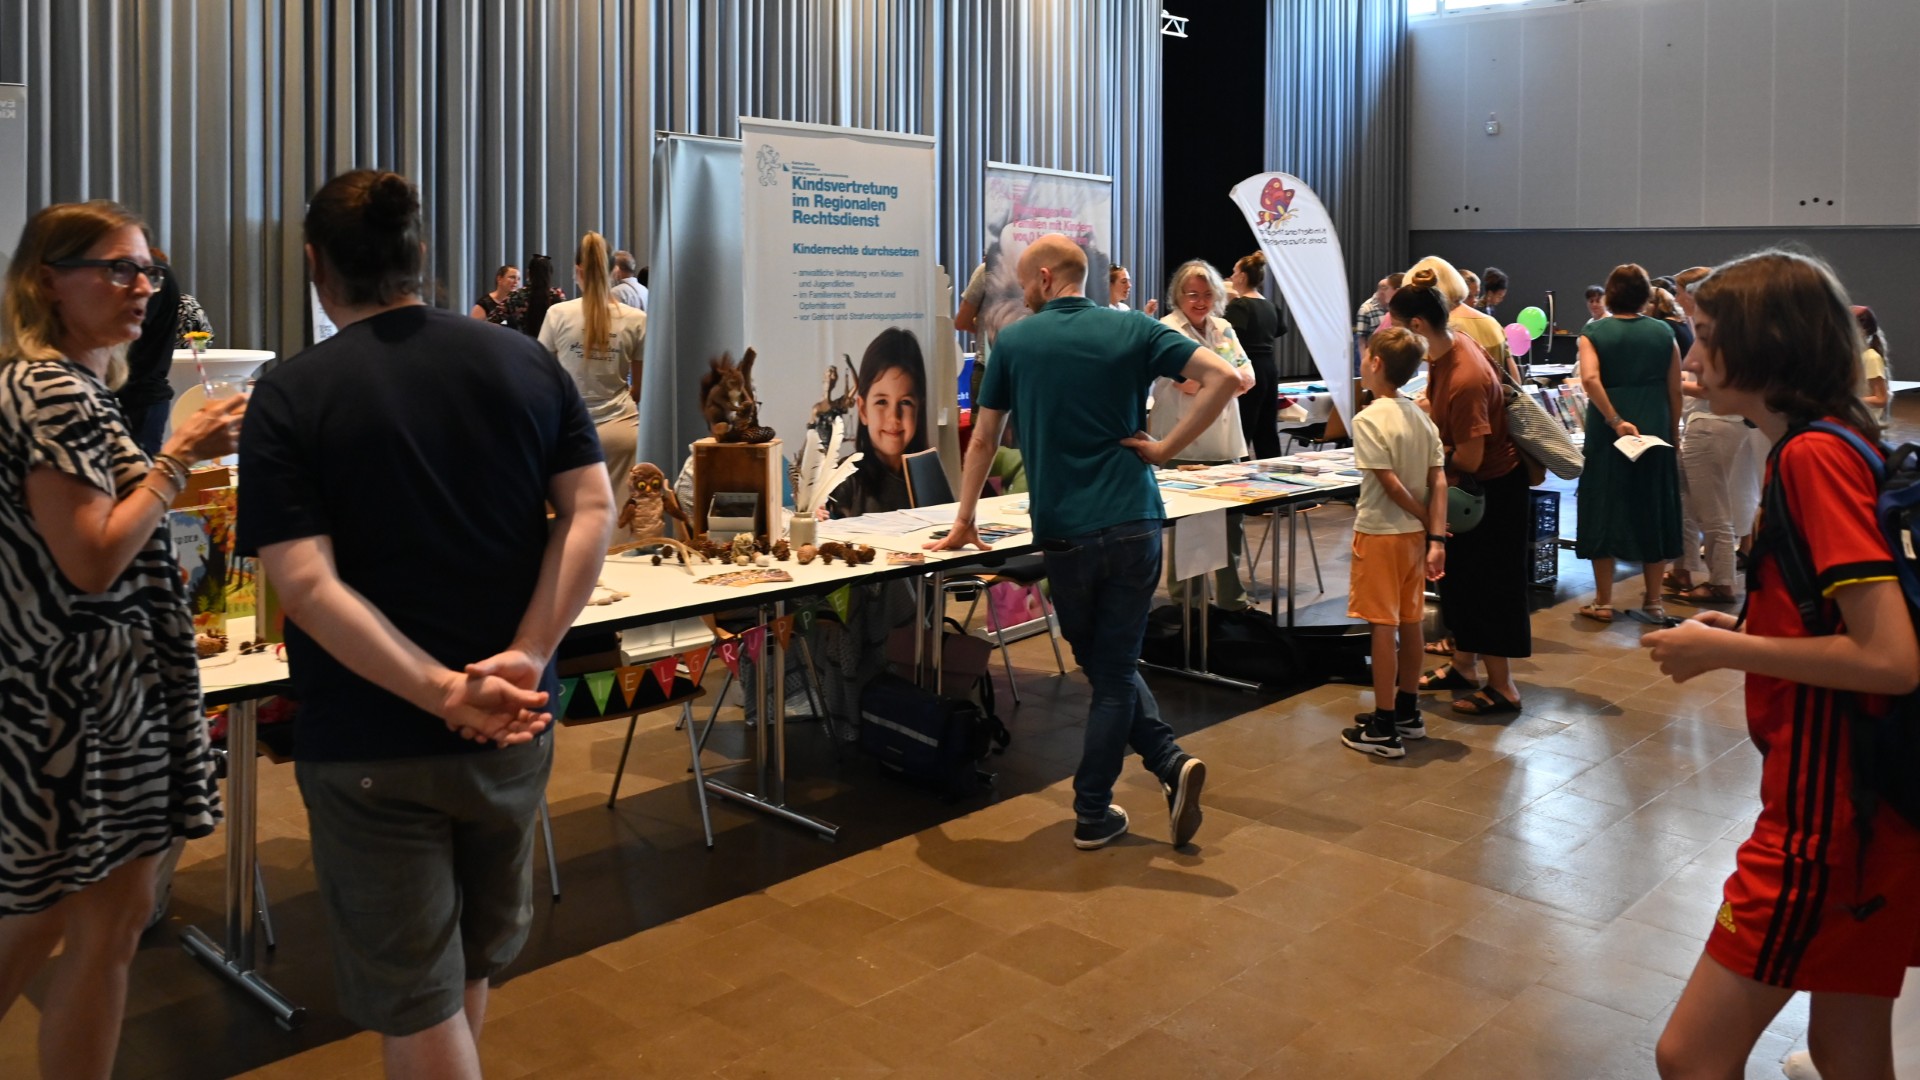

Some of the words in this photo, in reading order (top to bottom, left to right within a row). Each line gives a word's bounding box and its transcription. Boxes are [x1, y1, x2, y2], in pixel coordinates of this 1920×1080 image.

[792, 175, 898, 199] Kindsvertretung
[792, 192, 810, 208] im
[814, 194, 886, 212] Regionalen
[792, 210, 880, 227] Rechtsdienst
[793, 243, 859, 255] Kinderrechte
[861, 245, 920, 257] durchsetzen
[799, 280, 811, 288] und
[813, 280, 855, 290] Jugendlichen
[884, 291, 896, 299] und
[835, 313, 848, 321] und
